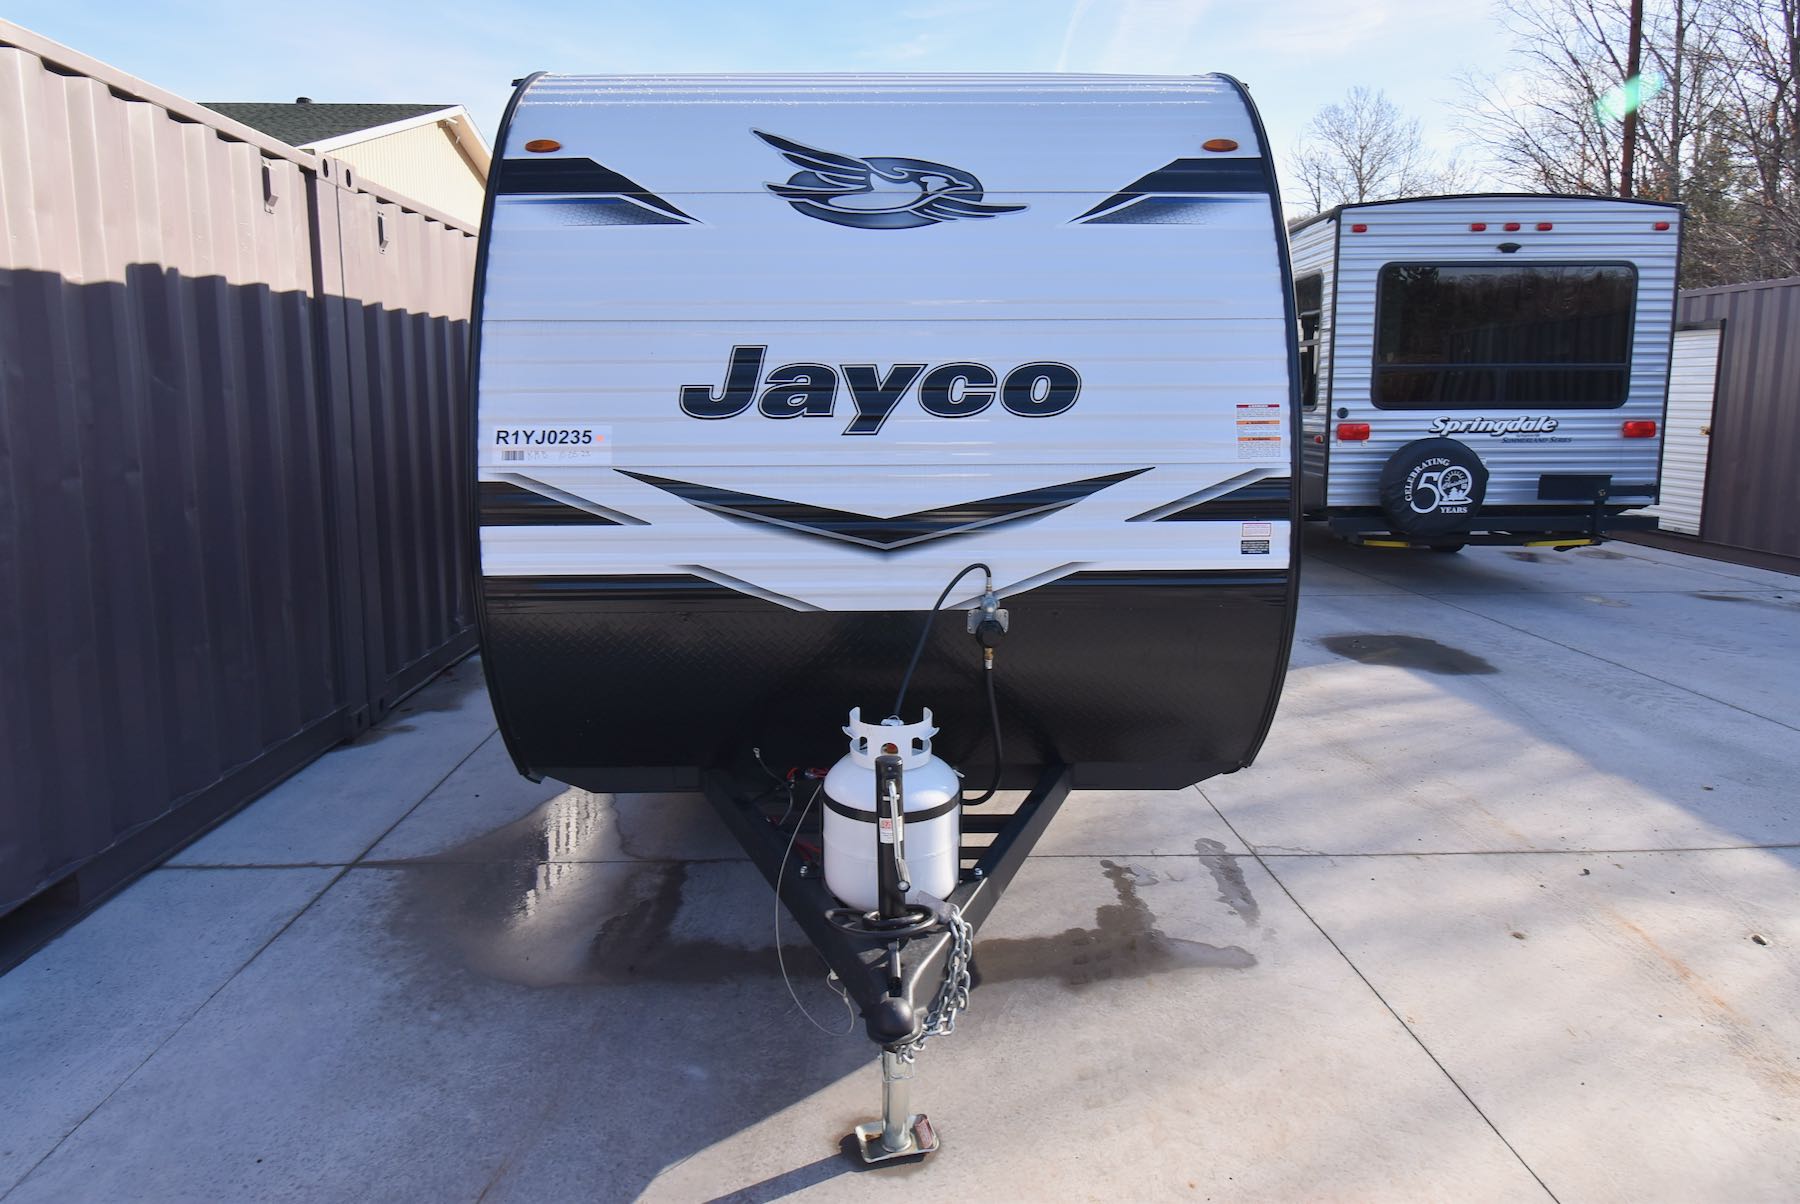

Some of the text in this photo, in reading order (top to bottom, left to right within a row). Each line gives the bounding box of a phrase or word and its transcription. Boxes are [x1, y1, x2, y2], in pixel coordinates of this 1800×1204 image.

[679, 344, 1082, 436] Jayco
[1429, 415, 1558, 436] Springdale
[495, 429, 593, 445] R1YJ0235
[1404, 457, 1451, 502] CELEBRATING
[1440, 506, 1468, 514] YEARS
